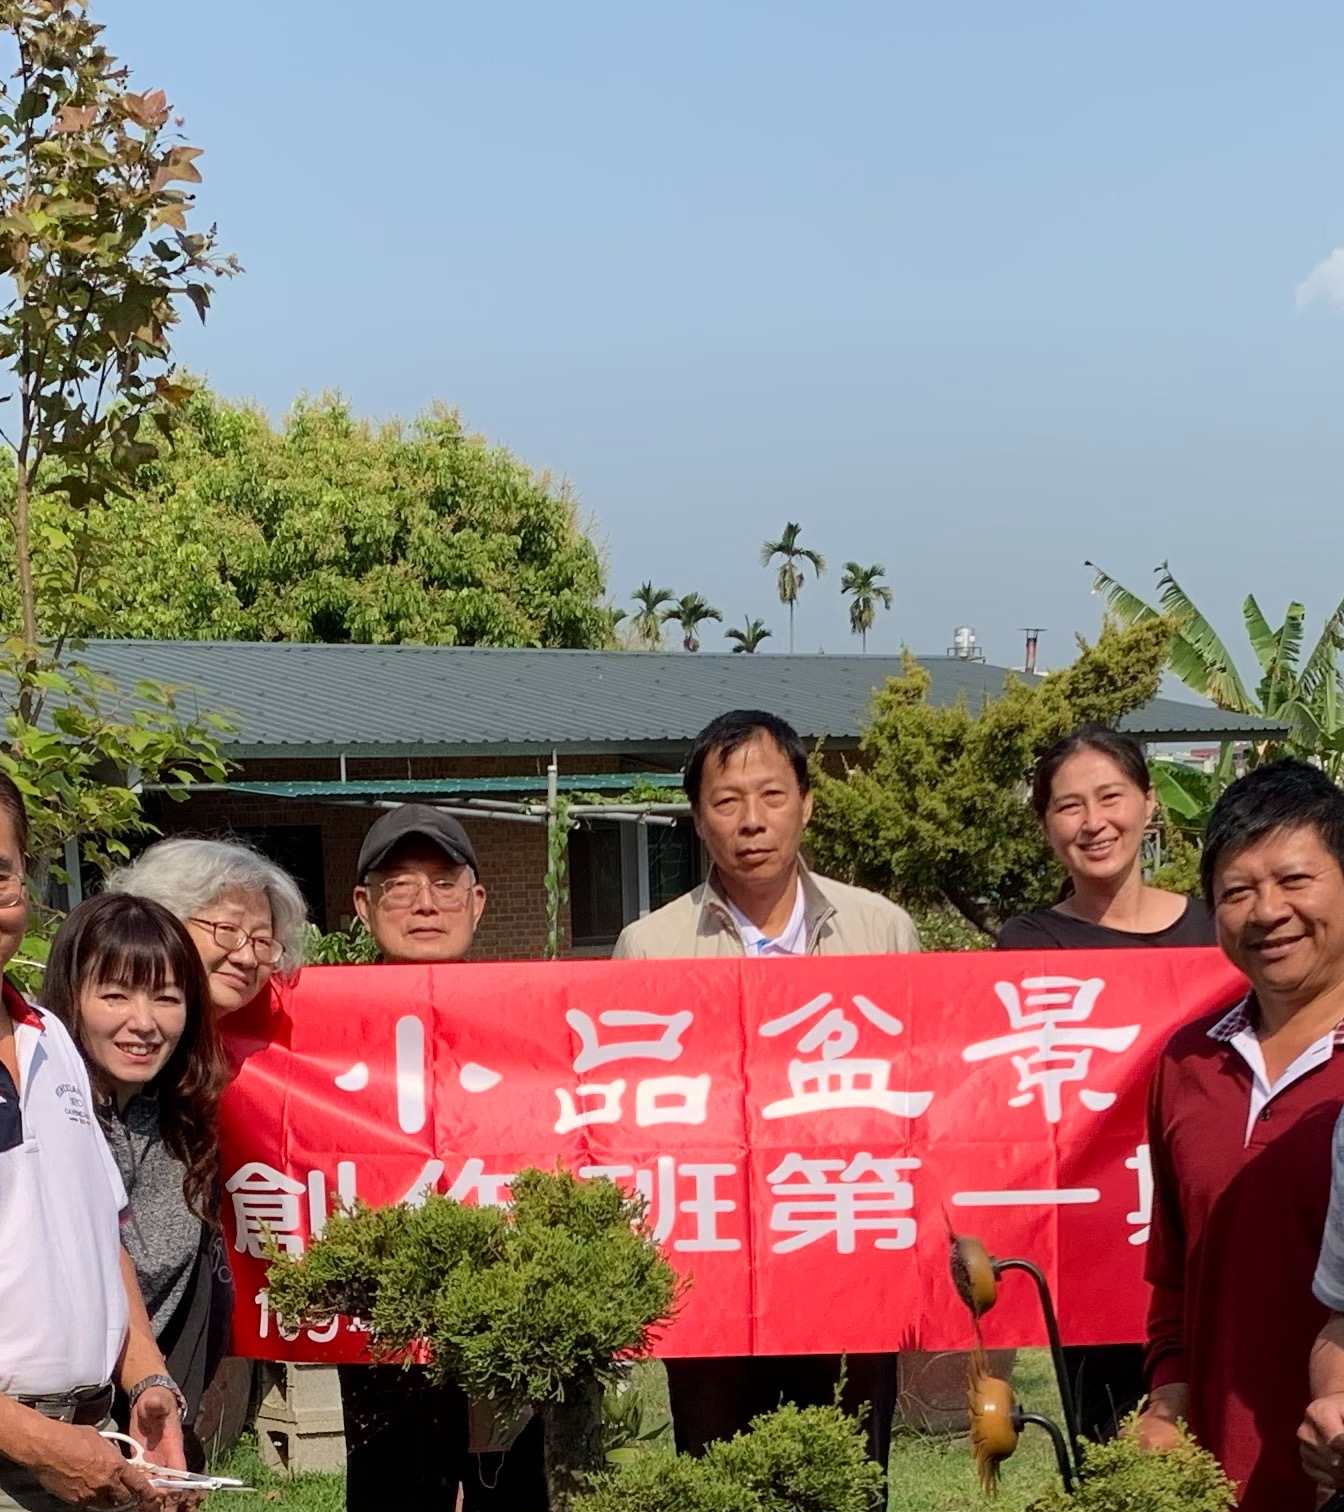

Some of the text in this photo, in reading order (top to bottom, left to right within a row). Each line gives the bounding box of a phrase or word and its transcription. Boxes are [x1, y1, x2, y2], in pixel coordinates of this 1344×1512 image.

[334, 975, 1140, 1134] 小品盆景
[225, 1144, 1154, 1260] 創班第一
